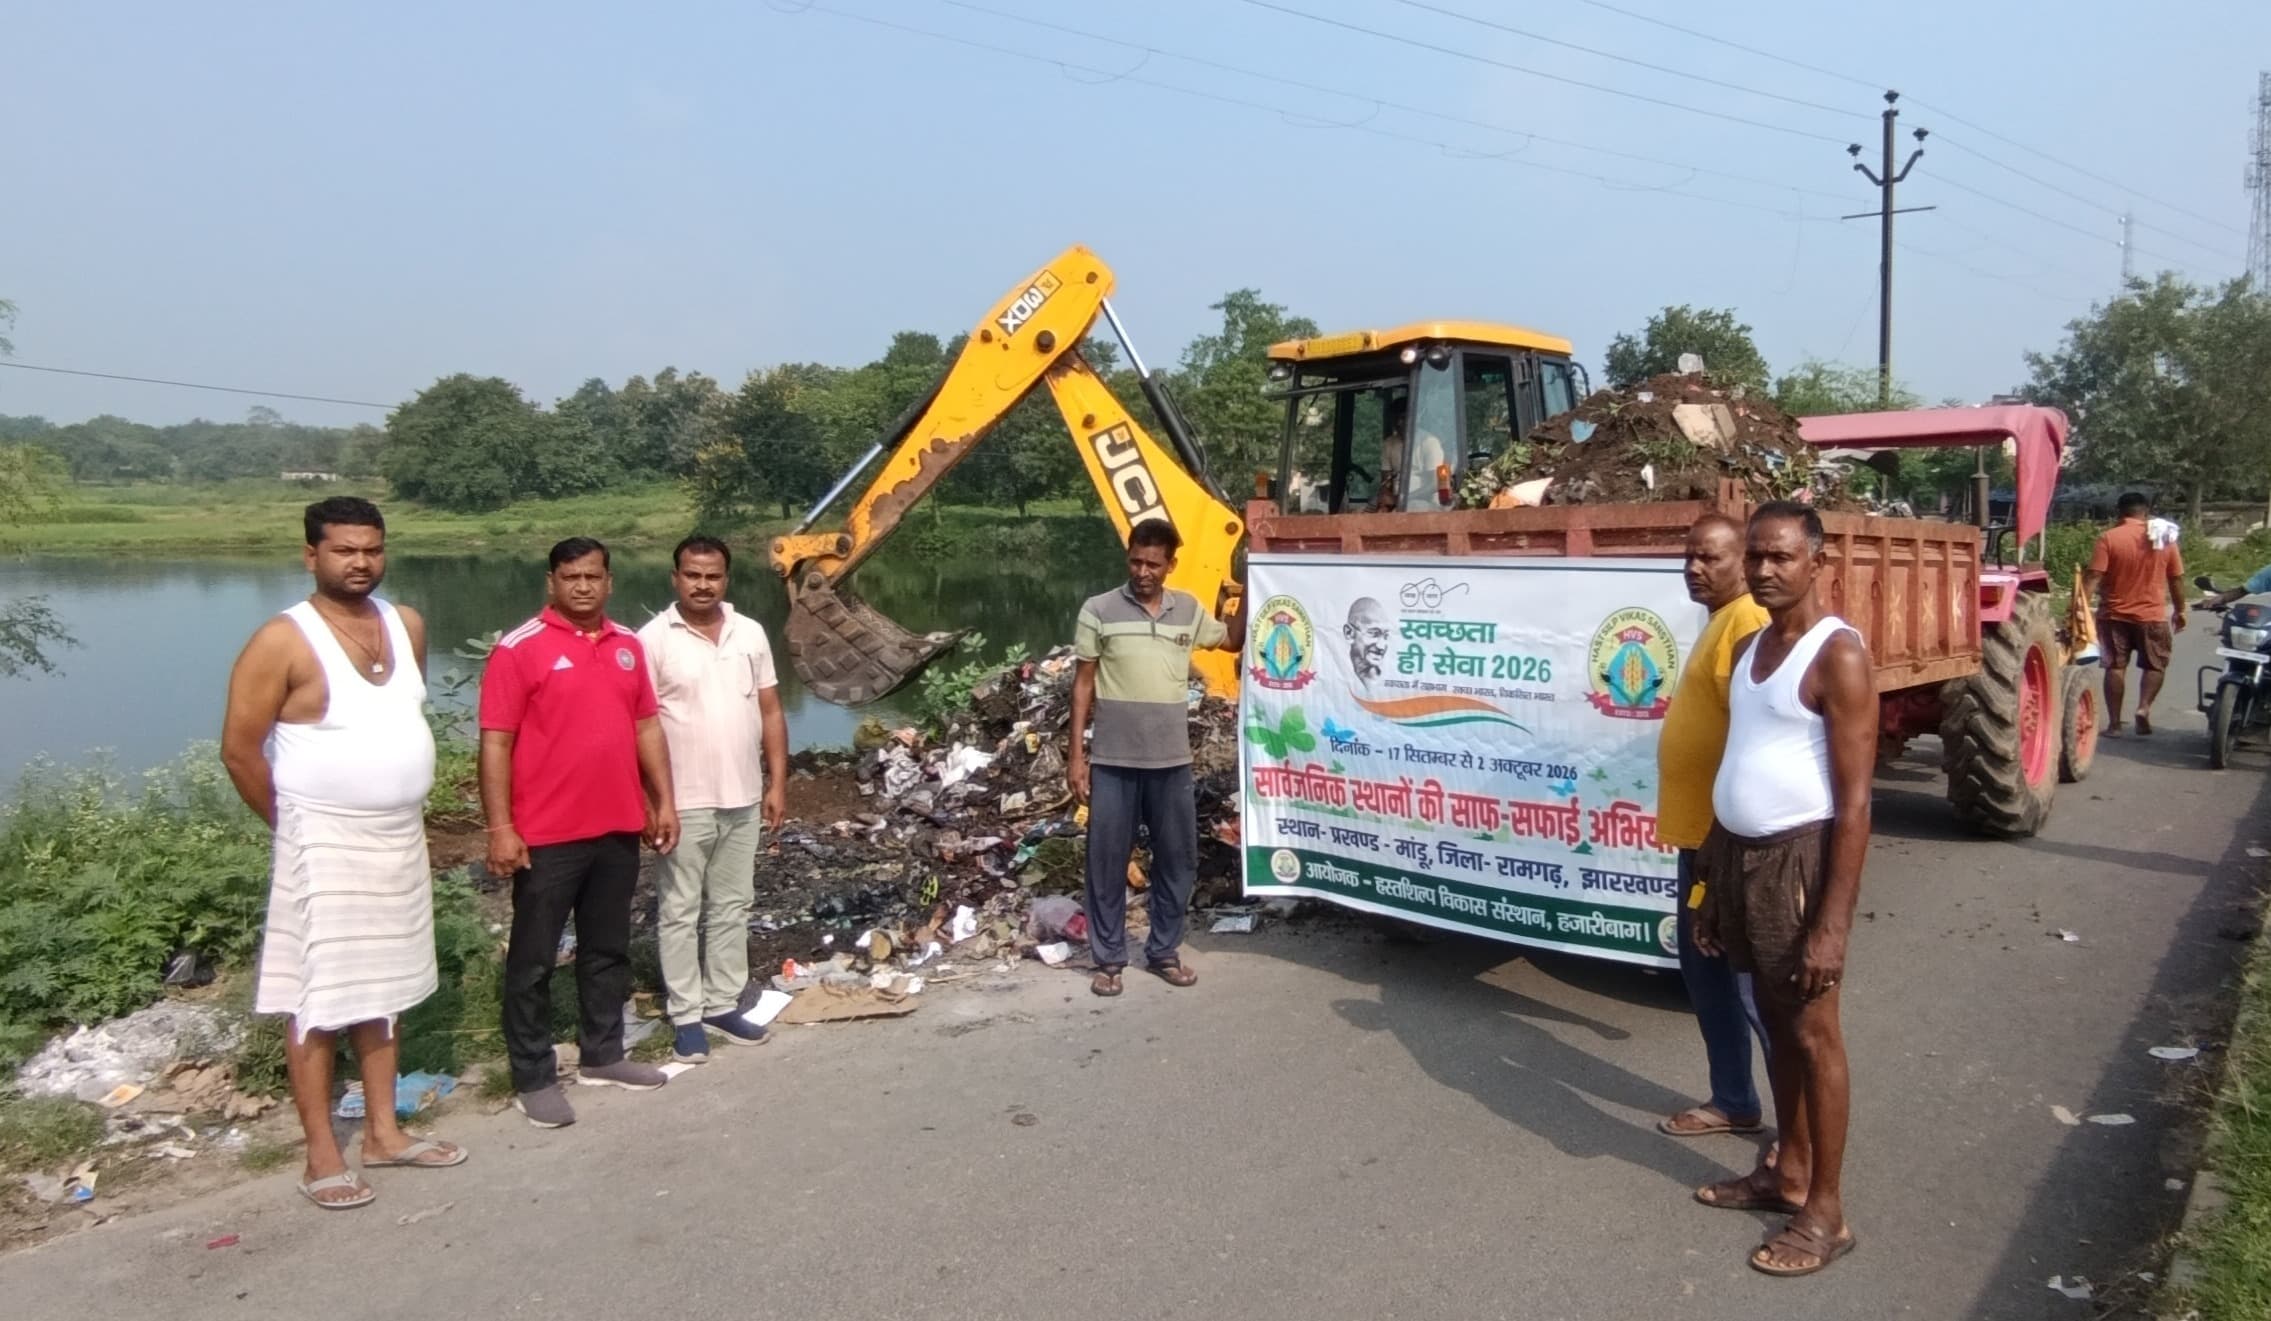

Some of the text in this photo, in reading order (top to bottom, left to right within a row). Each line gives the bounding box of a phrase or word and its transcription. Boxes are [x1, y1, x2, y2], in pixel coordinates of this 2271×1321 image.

[1095, 432, 1169, 528] JC
[1399, 618, 1498, 644] स्वच्छता
[1619, 611, 1646, 622] VIKAS
[1647, 616, 1676, 669] SANSTHAN
[1623, 629, 1643, 641] HVS
[1397, 643, 1552, 683] ही सेवा 2026
[1330, 735, 1371, 757] दिनांक
[1387, 747, 1400, 761] 17
[1403, 743, 1457, 767] सितम्बर
[1459, 750, 1473, 769] से
[1477, 757, 1484, 770] 2
[1488, 757, 1543, 781] अक्टूबर
[1546, 763, 1578, 781] 2026
[1252, 759, 1674, 854] सार्वजनिक स्थानों की साफ-सफाई अभिय
[1329, 826, 1381, 852] प्रखण्ड
[1394, 836, 1434, 869] मांडू,
[1495, 855, 1569, 889] रामगढ़,
[1579, 867, 1679, 898] झारखण्ड
[1305, 860, 1359, 888] आयोजक
[1374, 875, 1436, 906] हस्तशिल्प
[1438, 885, 1487, 917] विकास
[1491, 896, 1553, 931] संस्थान,
